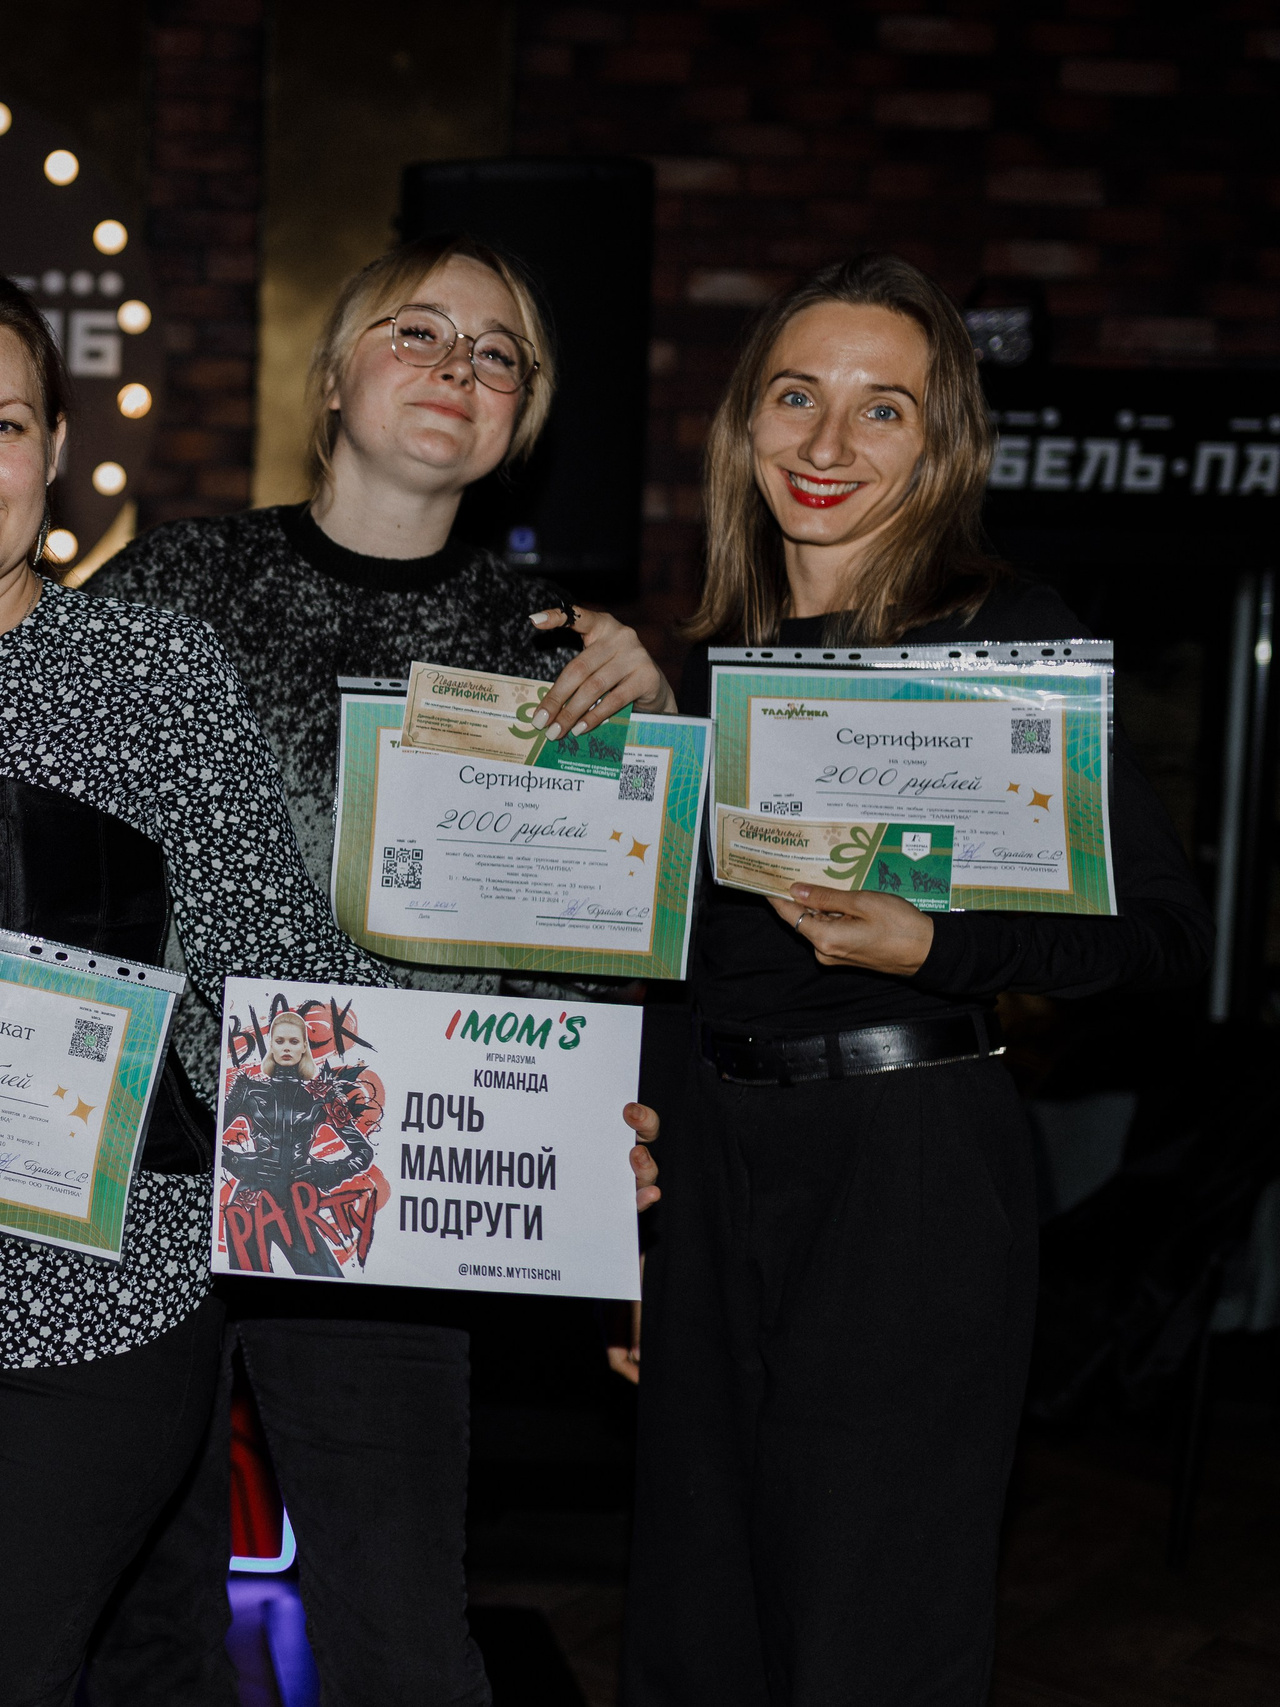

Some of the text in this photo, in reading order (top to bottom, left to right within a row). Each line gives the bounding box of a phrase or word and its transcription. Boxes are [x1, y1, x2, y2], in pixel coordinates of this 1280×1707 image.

[432, 685, 499, 703] СЕРТИФИКАТ
[836, 727, 973, 750] Сертификат
[459, 765, 584, 792] Сертификат
[815, 765, 983, 795] 2000 рублей
[437, 809, 588, 843] 2000 рублей
[740, 829, 810, 848] СЕРТИФИКАТ
[486, 1052, 536, 1066] ИГРЫ РАЗУМА
[473, 1068, 549, 1094] КОМАНДА
[401, 1091, 485, 1133] ДОЧЬ
[400, 1143, 557, 1191] МАМИНОЙ
[224, 1181, 378, 1273] PARTY
[399, 1195, 543, 1241] ПОДРУГИ
[458, 1263, 562, 1282] @IMOMS.MYTISHCHI
